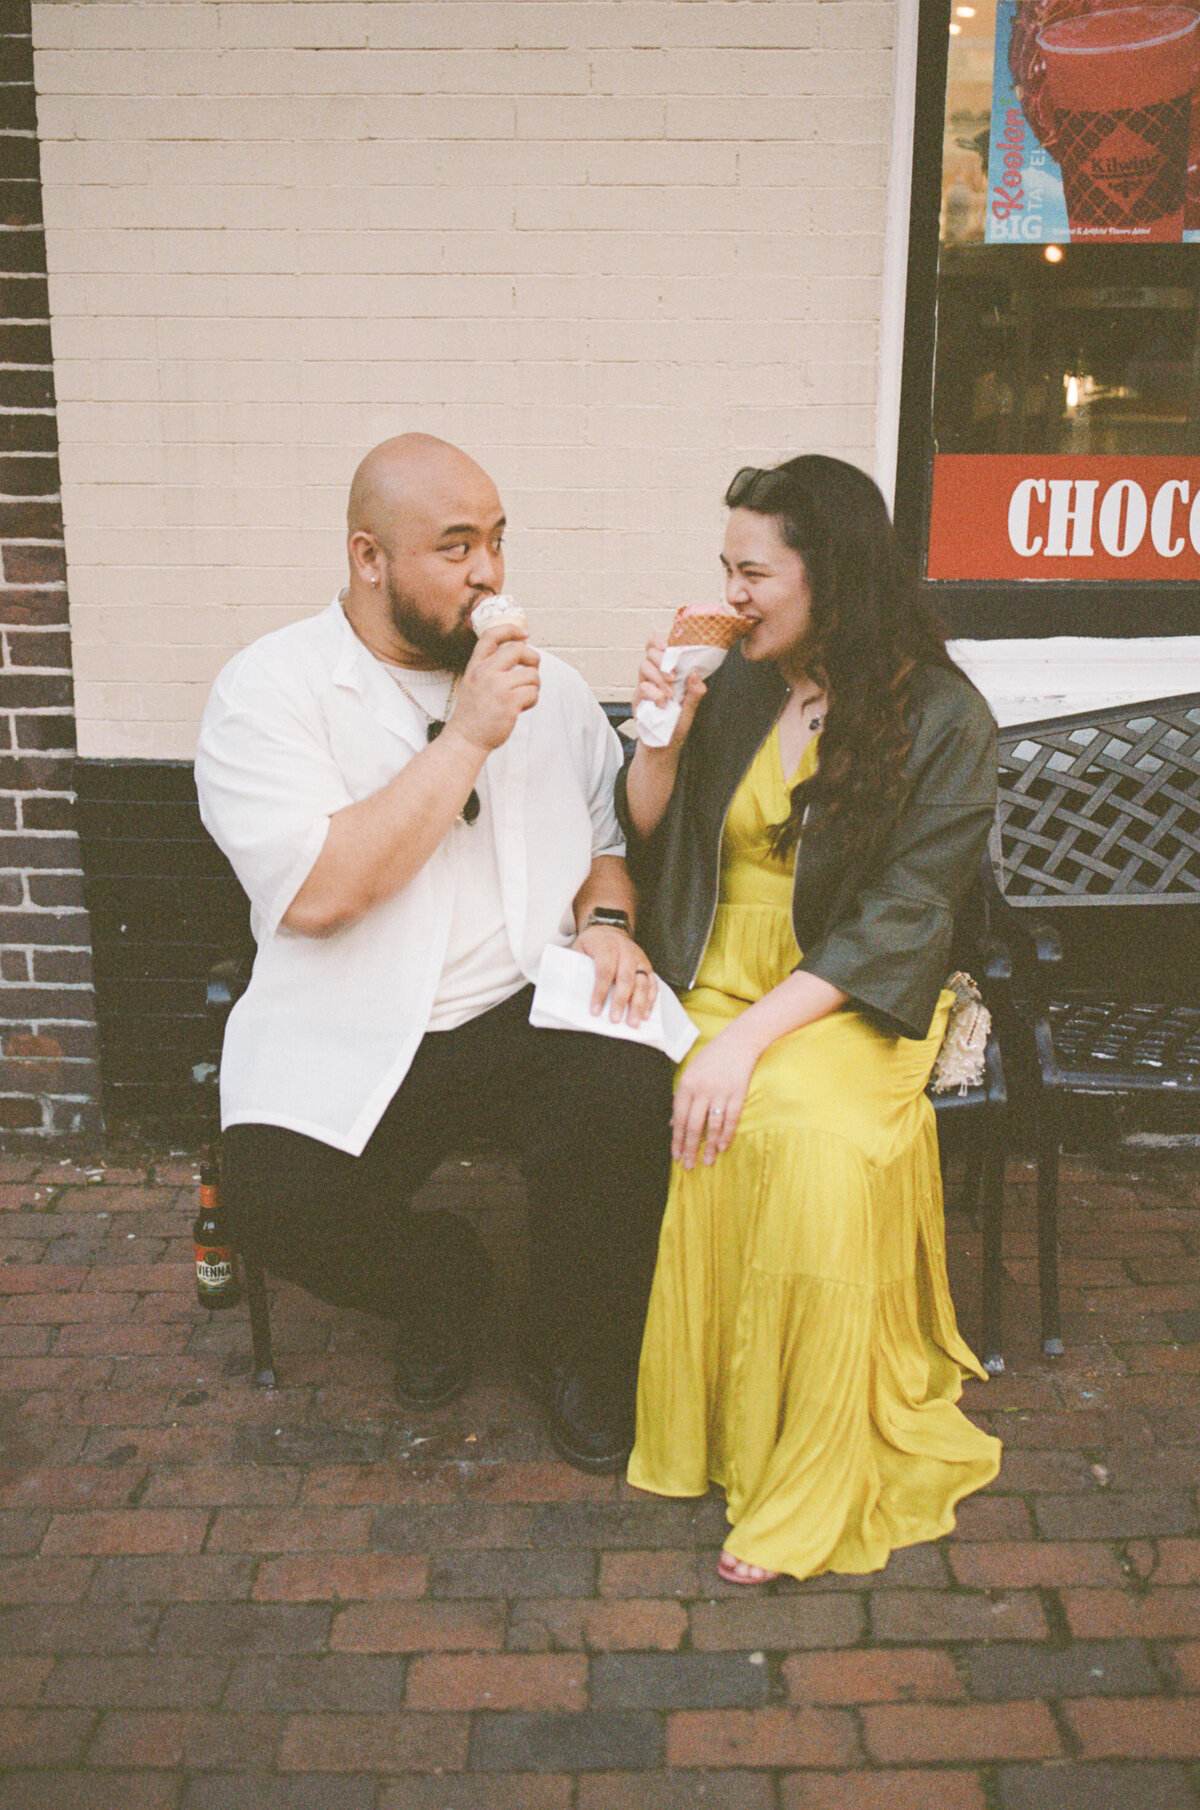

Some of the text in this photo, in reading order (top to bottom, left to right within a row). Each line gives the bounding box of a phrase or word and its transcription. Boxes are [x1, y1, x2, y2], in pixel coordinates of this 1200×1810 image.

[989, 215, 1042, 239] BIG
[1008, 478, 1200, 558] CHOC
[198, 1264, 232, 1278] VIENNA
